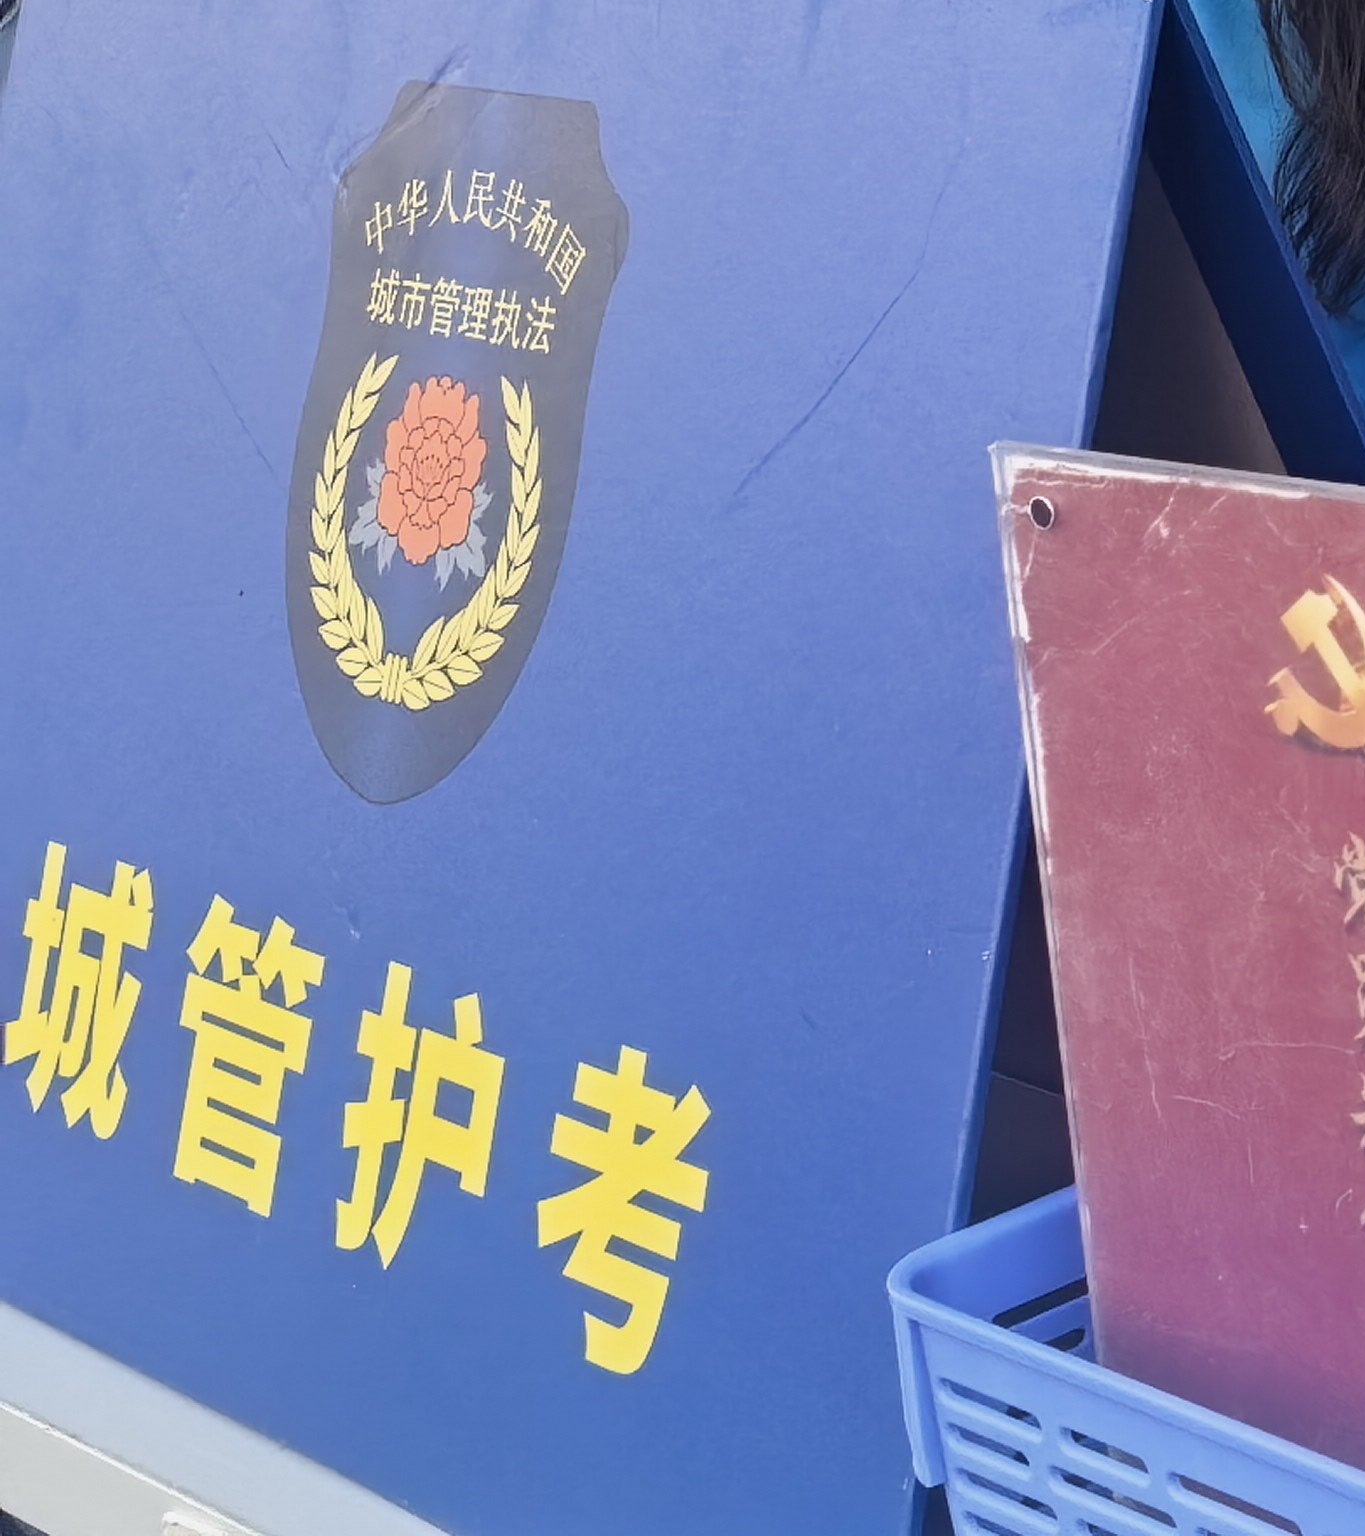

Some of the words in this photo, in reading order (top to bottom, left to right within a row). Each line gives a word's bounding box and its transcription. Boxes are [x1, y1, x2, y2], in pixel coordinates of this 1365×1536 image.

[364, 168, 587, 295] 中华人民共和国
[367, 268, 558, 356] 城市管理执法
[4, 841, 712, 1375] 城管护考
